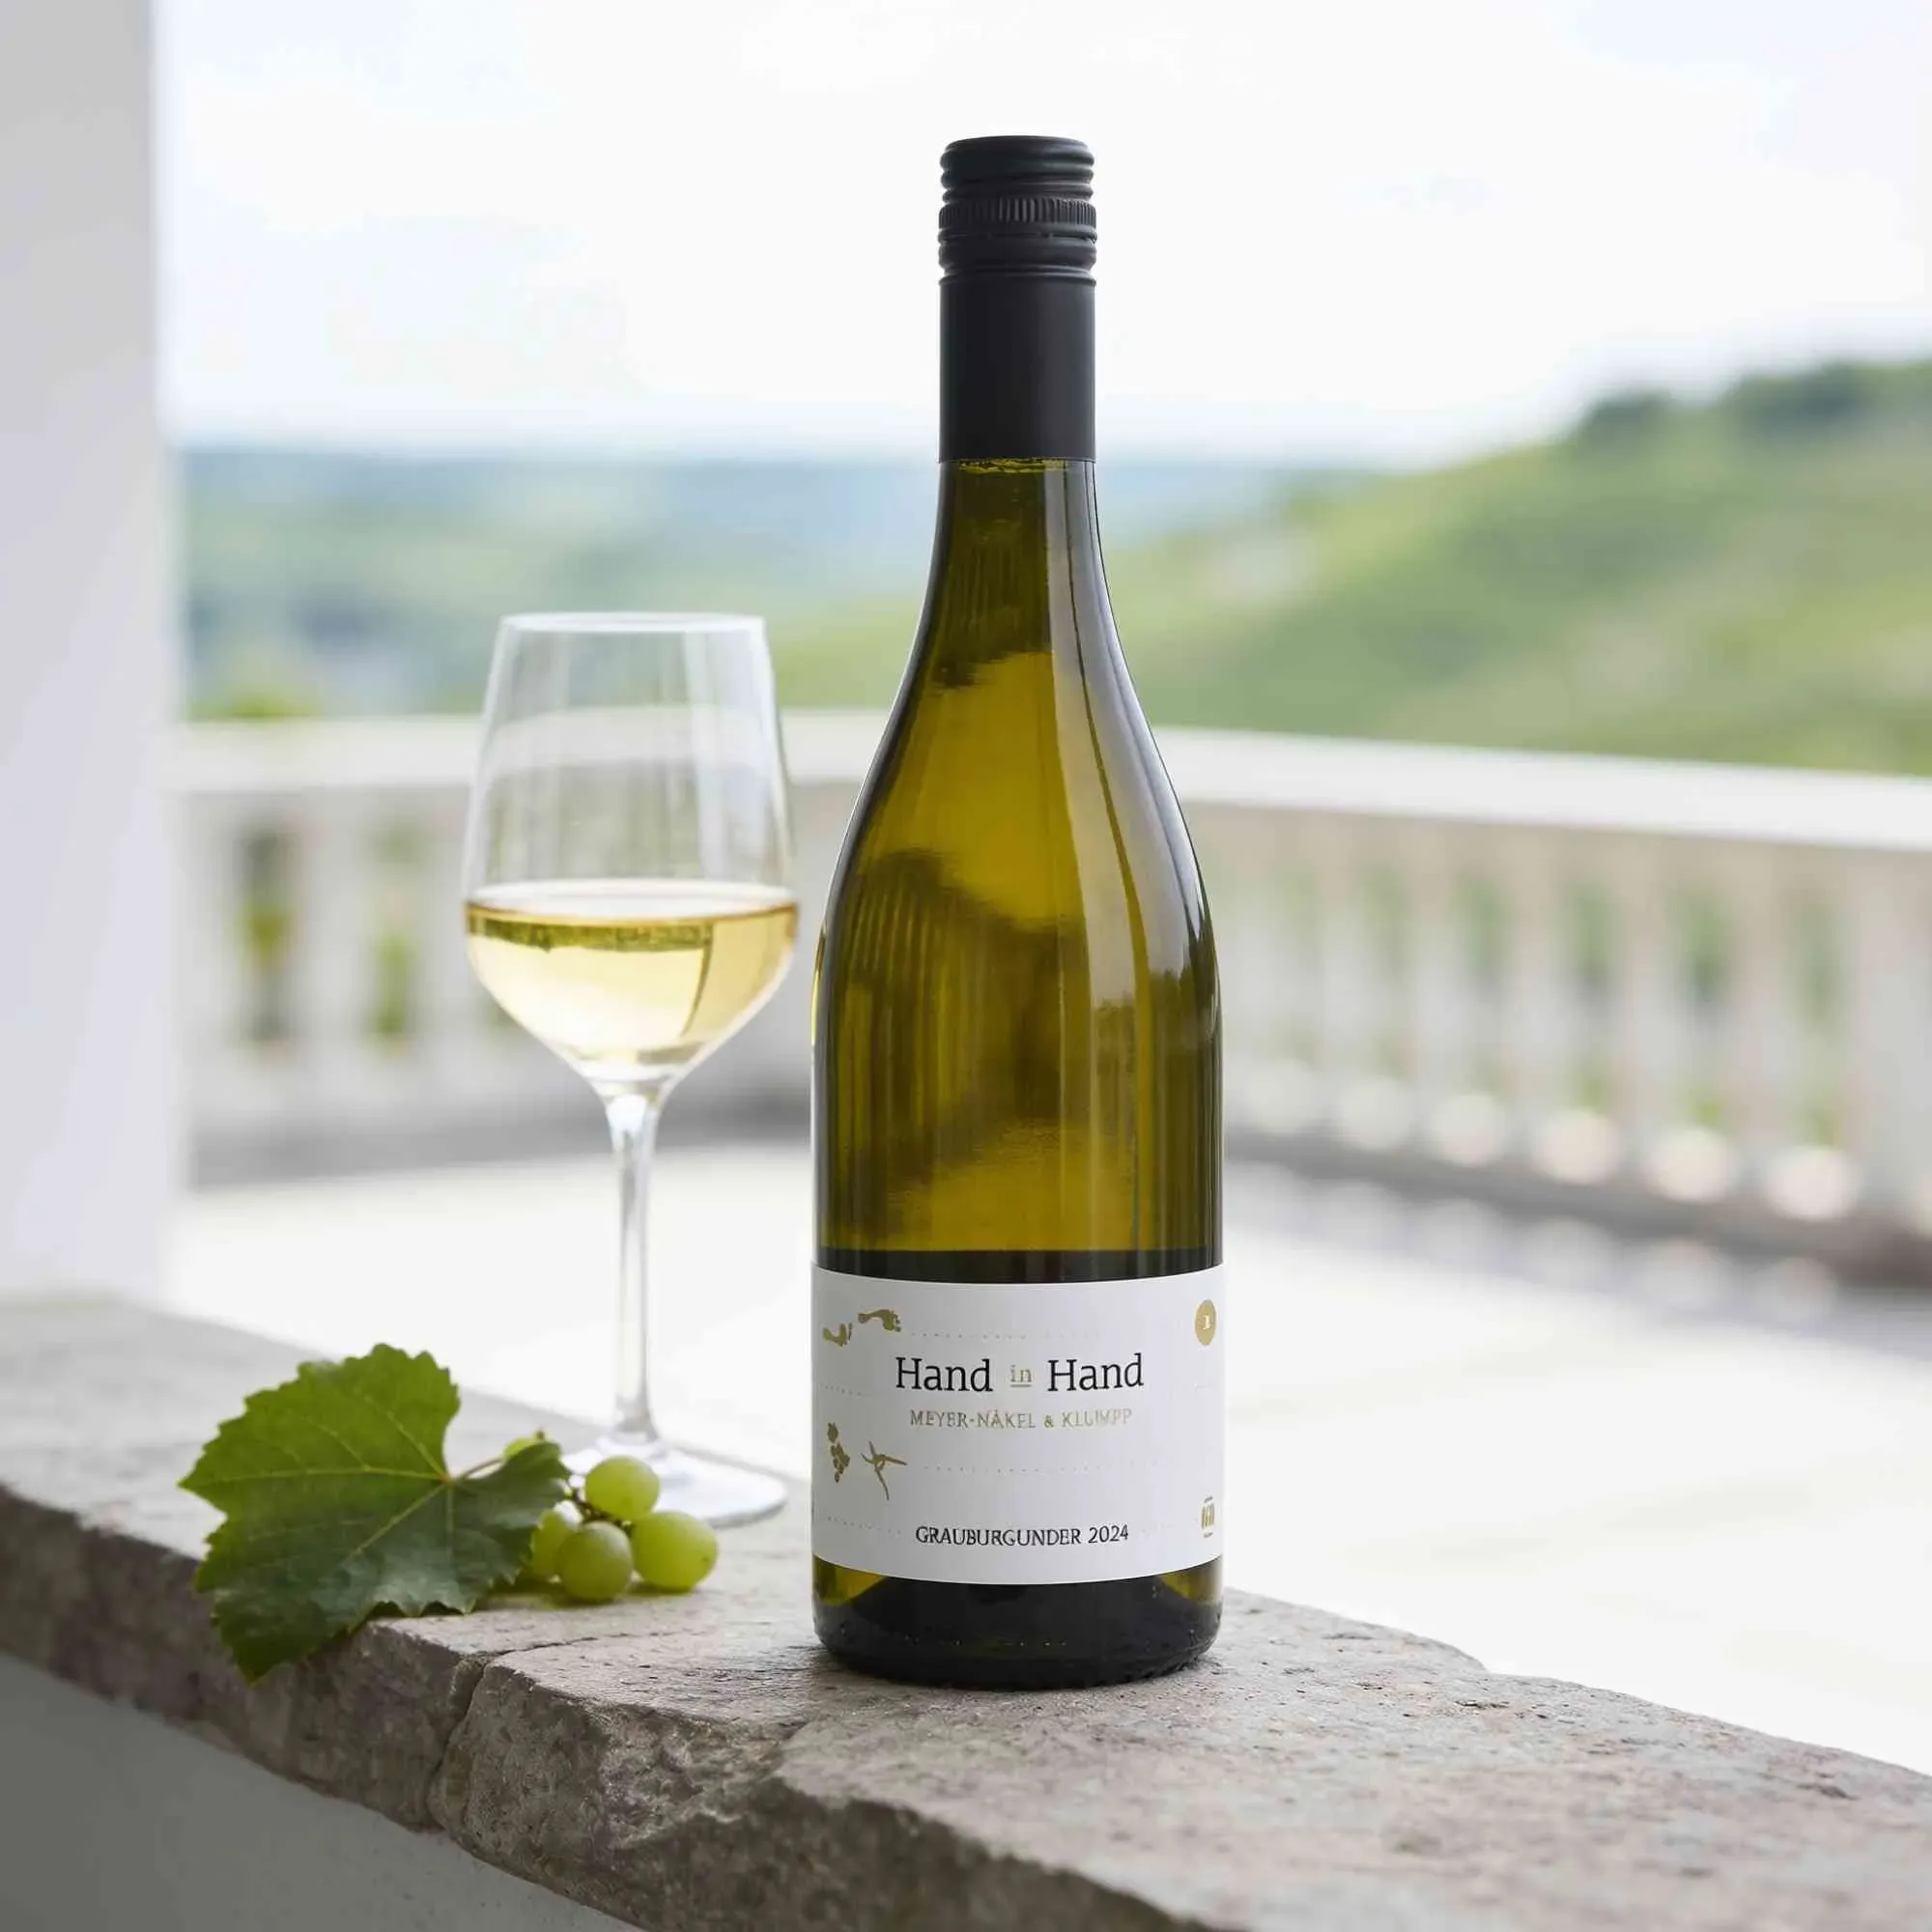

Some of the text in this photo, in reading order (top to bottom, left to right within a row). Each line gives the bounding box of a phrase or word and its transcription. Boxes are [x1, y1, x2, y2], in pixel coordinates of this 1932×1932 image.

[895, 1352, 1144, 1392] Hand in Hand
[1043, 1414, 1055, 1429] &
[916, 1523, 1129, 1546] GRAUBURGUNDER 2024
